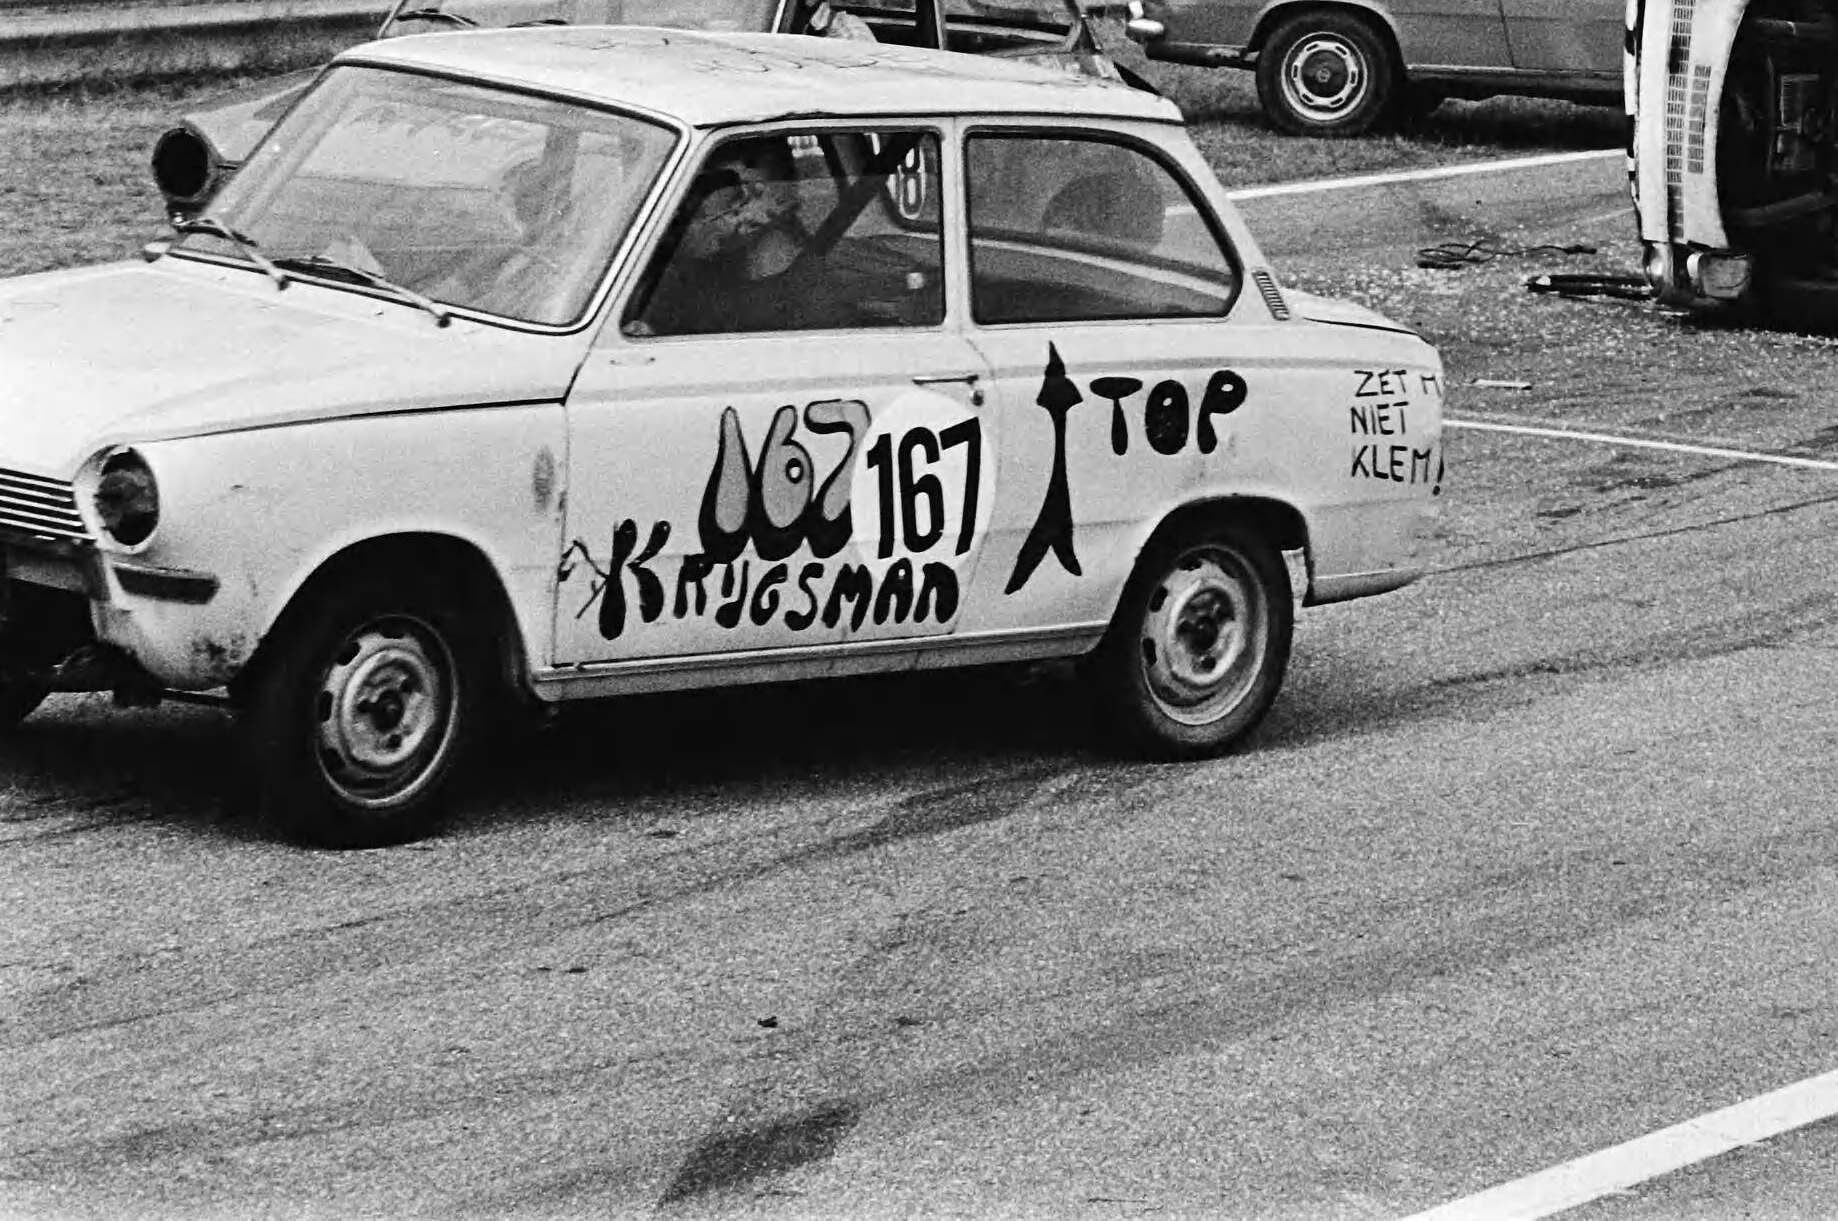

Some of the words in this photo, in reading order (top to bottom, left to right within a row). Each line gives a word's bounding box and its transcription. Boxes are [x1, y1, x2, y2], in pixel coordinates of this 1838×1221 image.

[1089, 369, 1248, 456] TOP
[1353, 369, 1408, 398] ZET
[1350, 400, 1410, 435] NIET
[866, 416, 982, 560] 167
